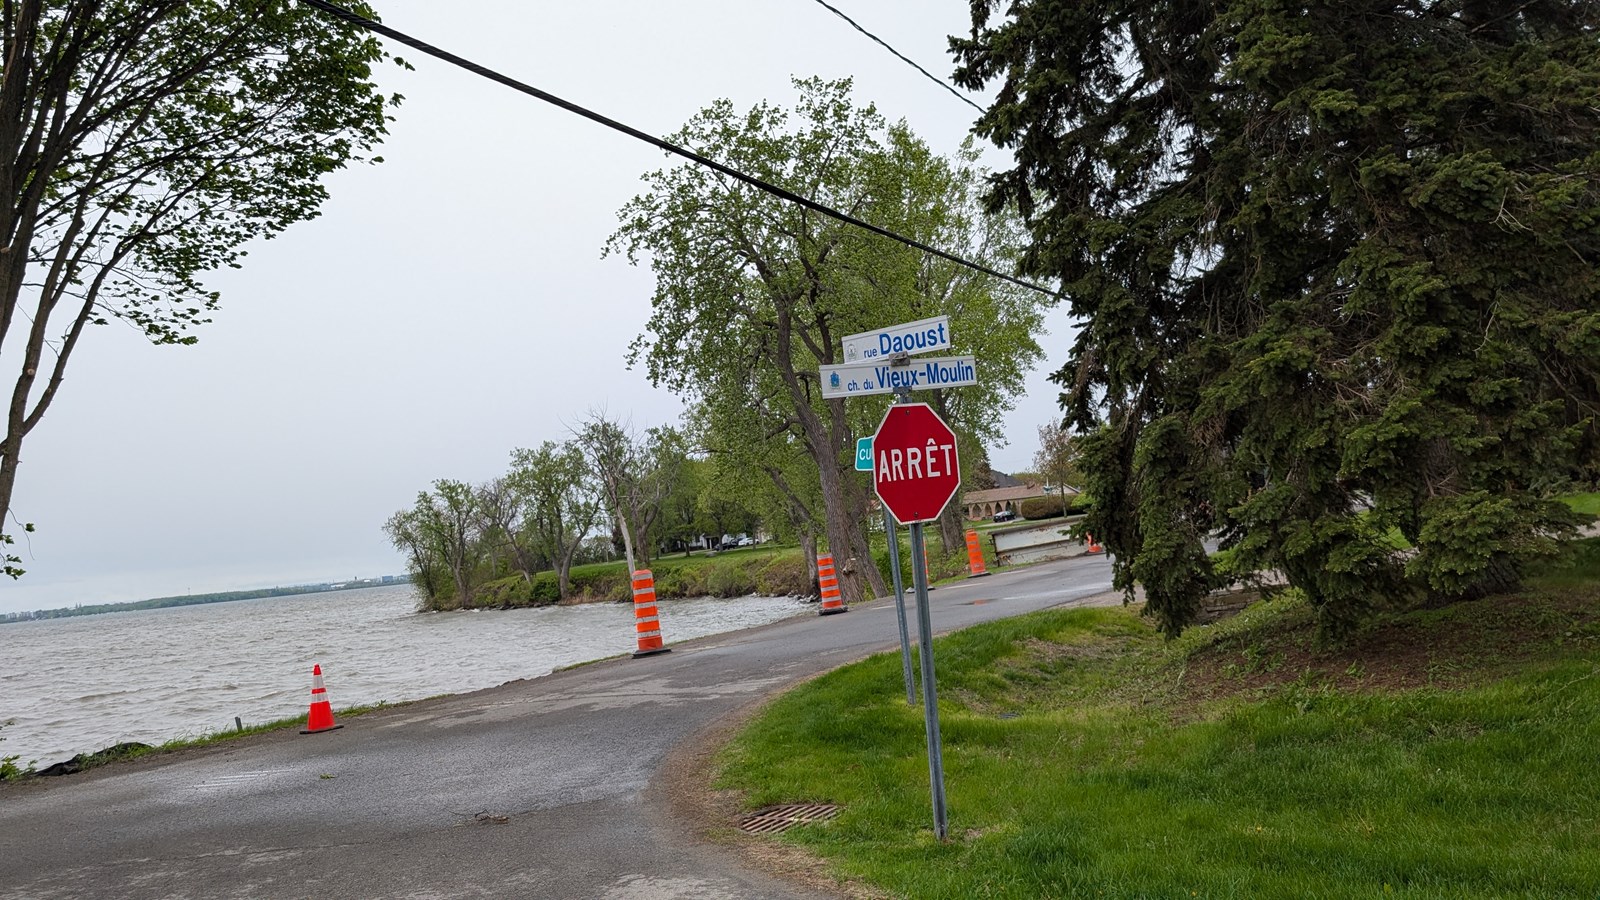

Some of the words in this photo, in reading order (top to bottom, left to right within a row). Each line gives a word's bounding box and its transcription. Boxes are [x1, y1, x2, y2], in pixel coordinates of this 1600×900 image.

[863, 347, 878, 358] rue
[879, 323, 946, 355] Daoust
[847, 379, 860, 392] ch.
[863, 378, 874, 390] du
[875, 361, 974, 388] Vieux-Moulin
[859, 448, 873, 461] CU
[878, 437, 953, 483] ARRÊT
